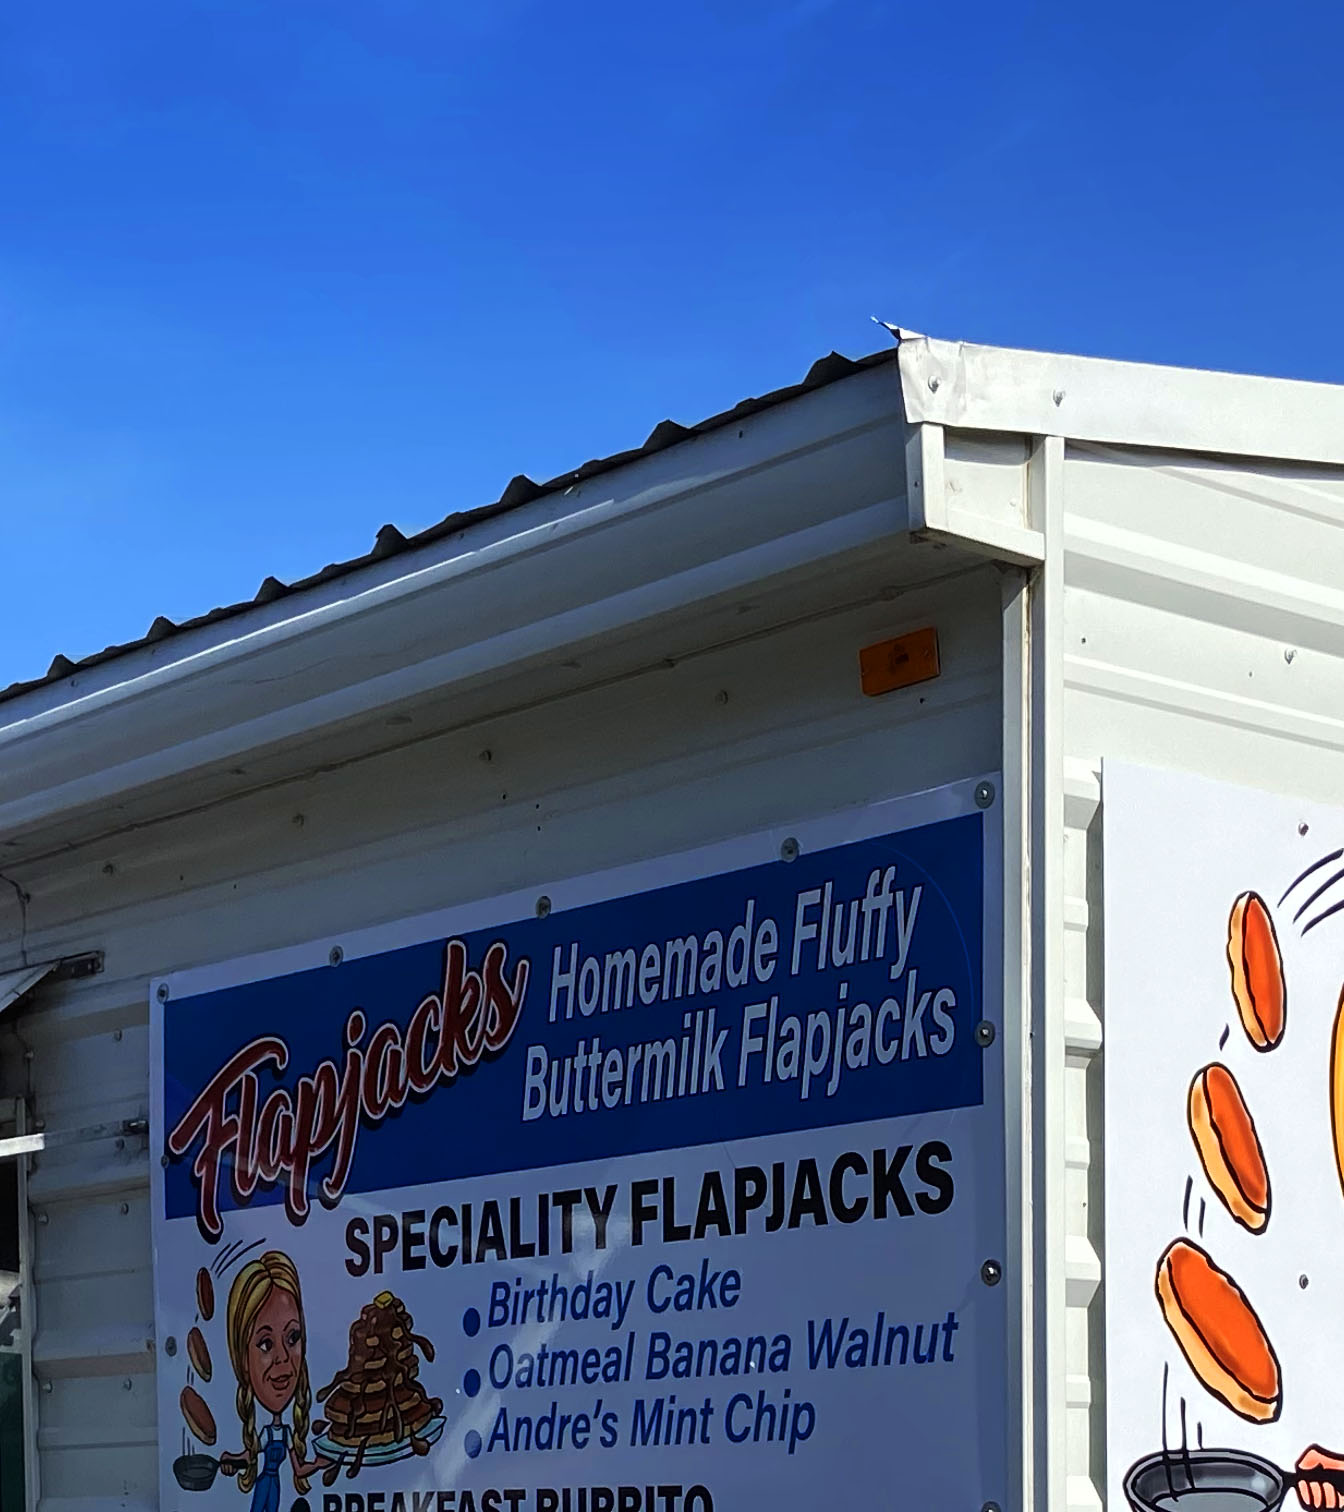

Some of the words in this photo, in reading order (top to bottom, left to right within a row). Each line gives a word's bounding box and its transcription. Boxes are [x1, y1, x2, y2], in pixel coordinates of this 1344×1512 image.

[549, 899, 778, 1023] Homemade
[791, 865, 923, 980] Fluffy
[168, 938, 530, 1240] Flapjacks
[522, 1007, 729, 1122] Buttermilk
[737, 969, 957, 1100] Flapjacks
[344, 1183, 619, 1277] SPECIALITY
[631, 1140, 955, 1246] FLAPJACKS
[487, 1268, 636, 1331] Birthday
[647, 1258, 742, 1314] Cake
[489, 1332, 635, 1391] Oatmeal
[645, 1323, 792, 1381] Banana
[807, 1312, 960, 1371] Walnut
[486, 1398, 619, 1455] Andre's
[630, 1395, 713, 1448] Mint
[724, 1388, 816, 1455] Chip
